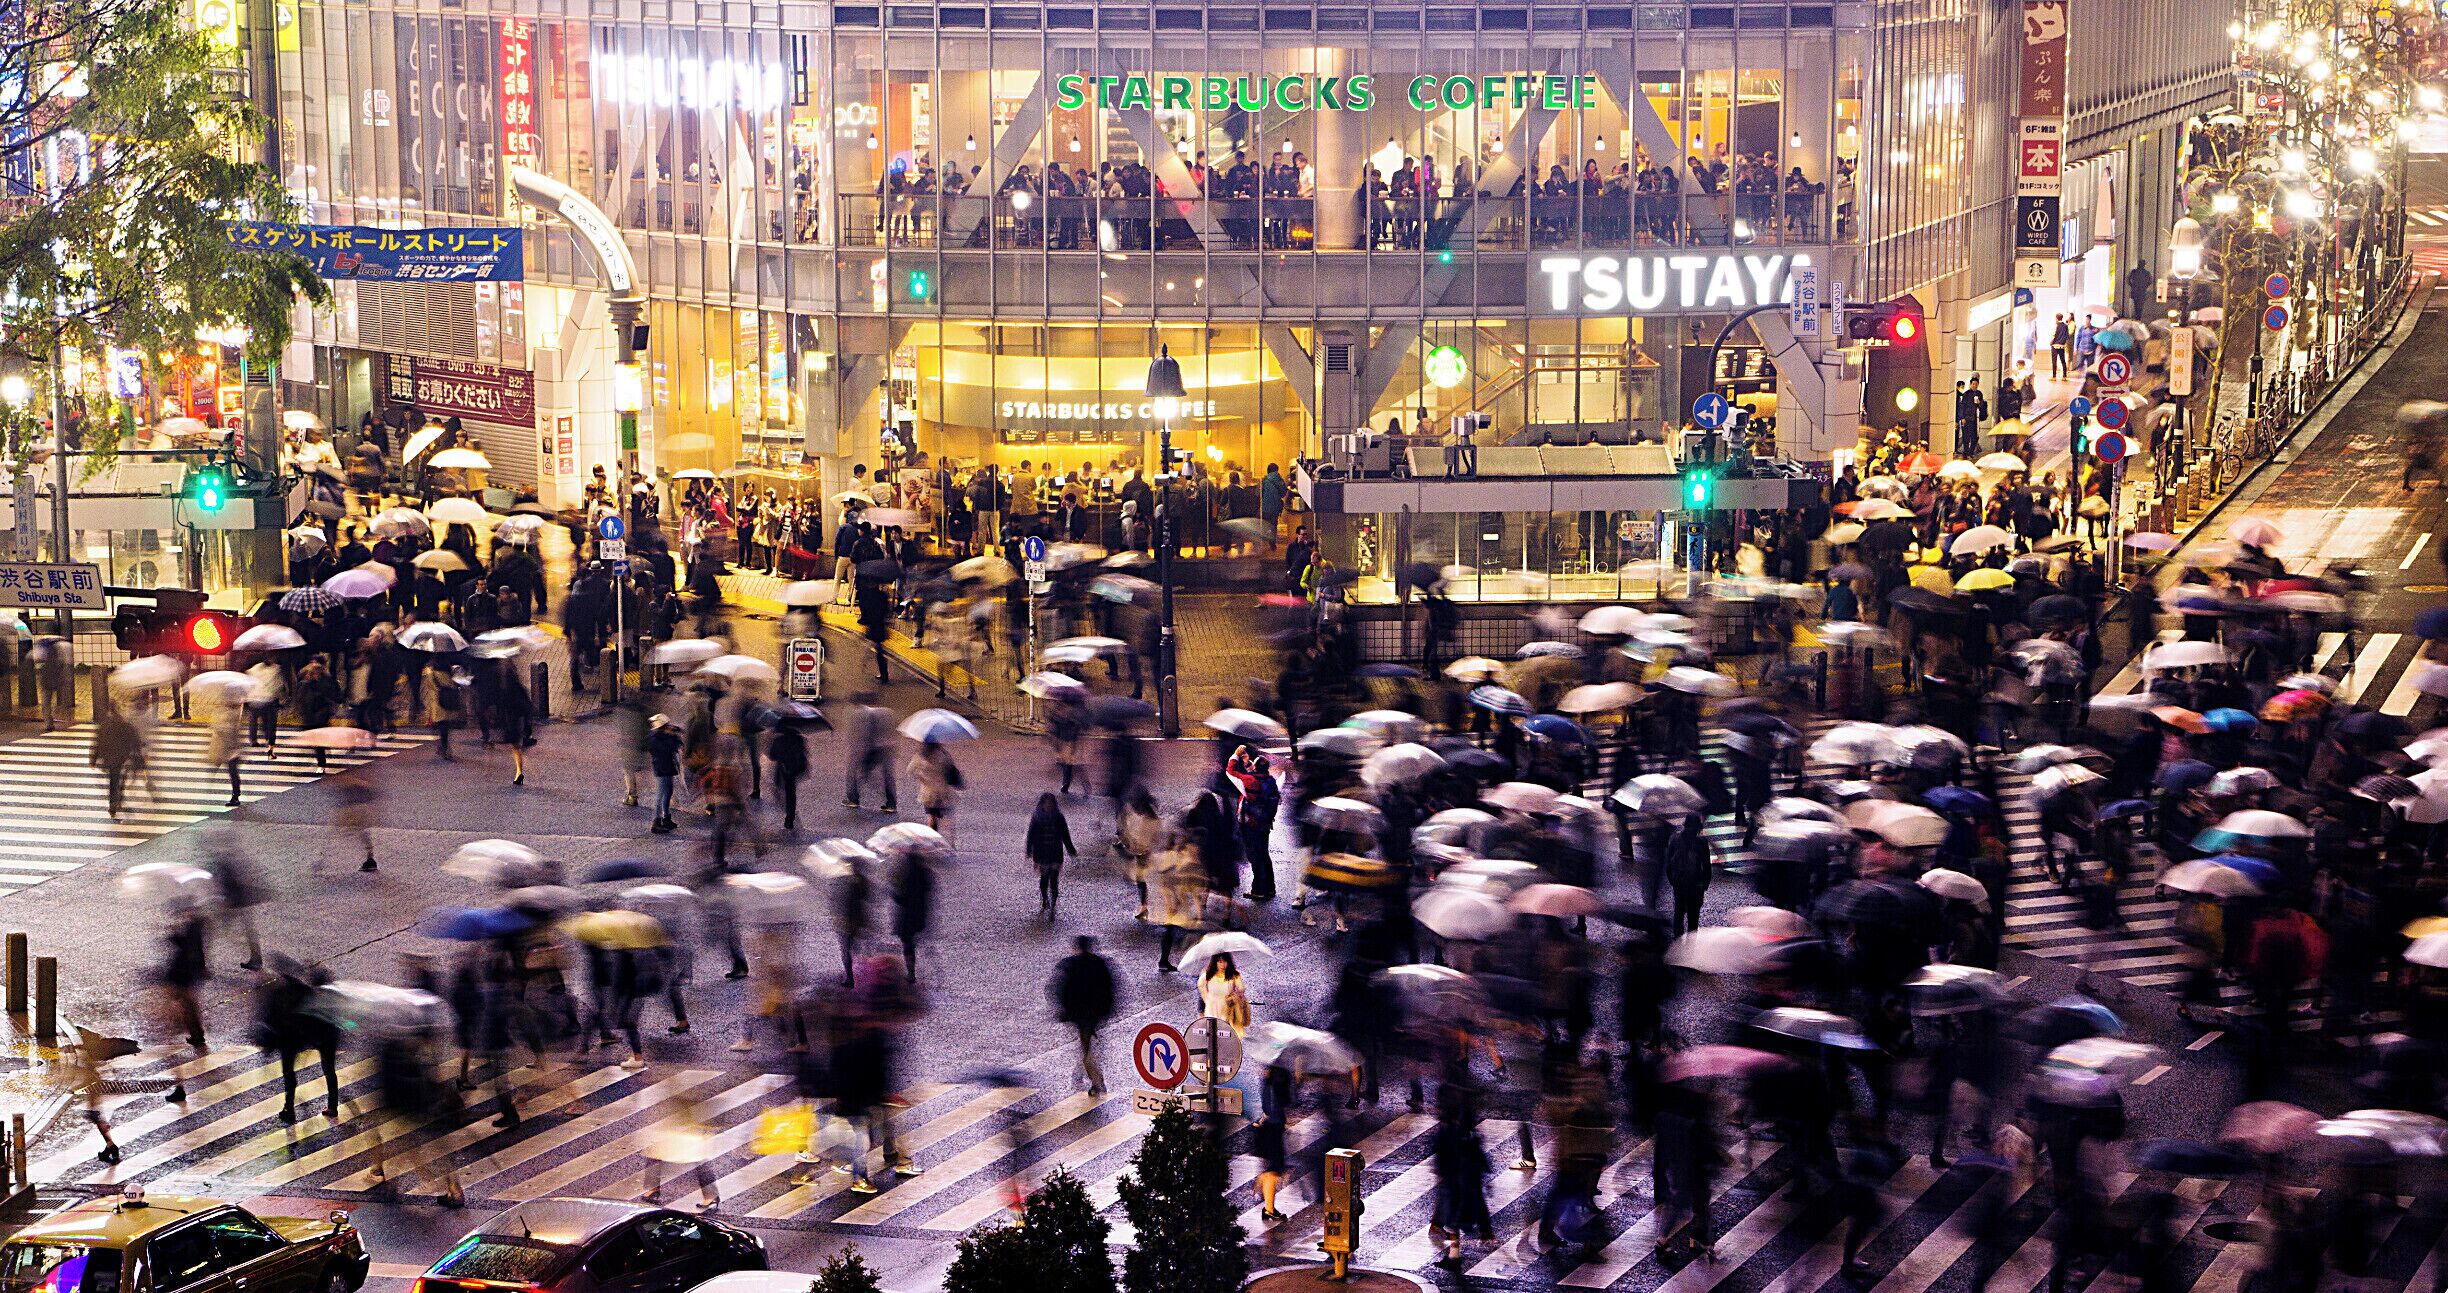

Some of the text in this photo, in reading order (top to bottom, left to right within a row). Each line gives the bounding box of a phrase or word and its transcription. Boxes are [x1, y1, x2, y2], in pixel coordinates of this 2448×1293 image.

[1056, 75, 1597, 111] STARBUCKS COFFEE
[2026, 144, 2054, 173] 本
[2032, 199, 2044, 208] 6F
[395, 263, 495, 279] 渋谷センター街
[1802, 271, 1816, 332] 渋谷駅前
[418, 378, 501, 409] お売りください
[1002, 401, 1133, 419] STARBUCKS
[0, 568, 93, 590] 渋谷駅前
[17, 591, 87, 604] Shibuya Sta.
